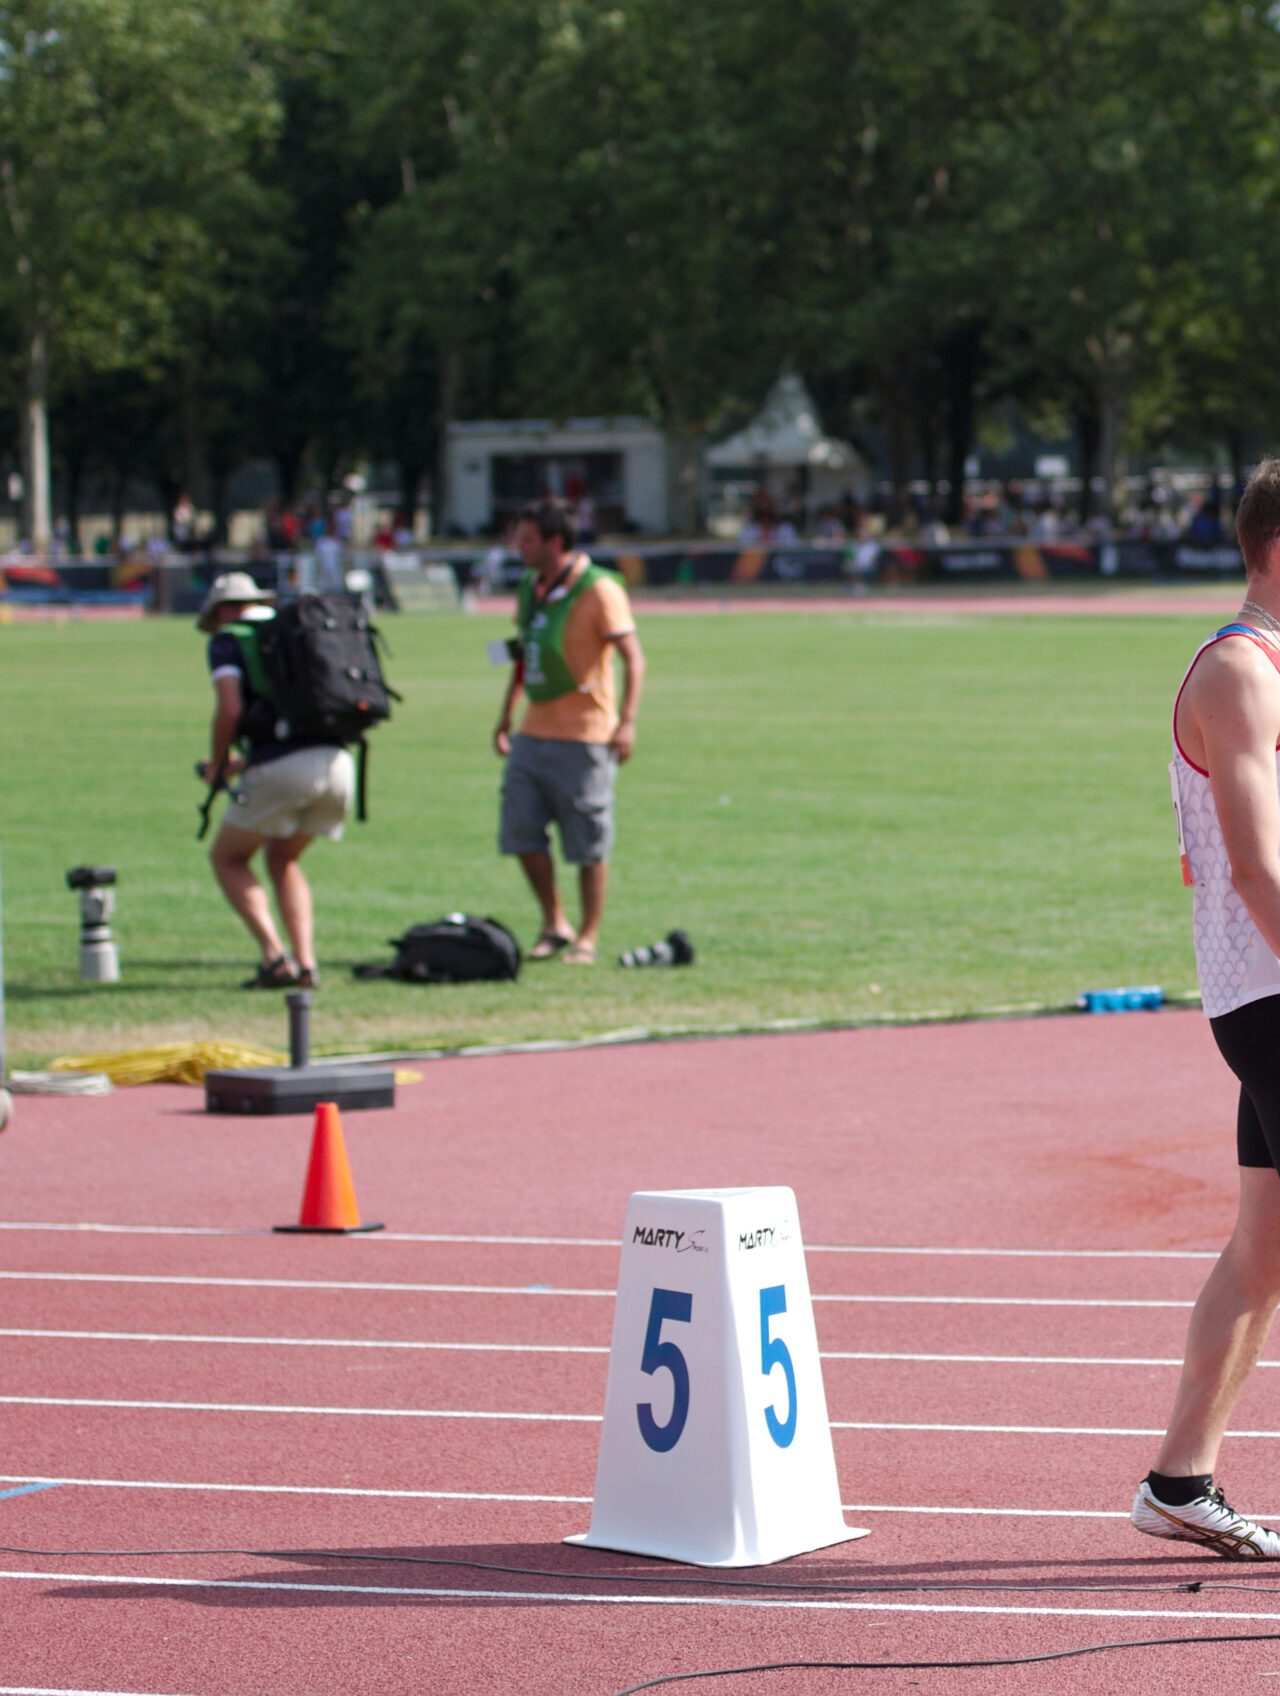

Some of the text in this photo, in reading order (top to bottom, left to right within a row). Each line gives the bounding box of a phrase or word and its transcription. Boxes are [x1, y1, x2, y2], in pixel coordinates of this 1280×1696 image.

[632, 1226, 685, 1249] MARTY
[738, 1226, 776, 1251] MARTY
[637, 1288, 693, 1453] 5
[759, 1284, 798, 1449] 5
